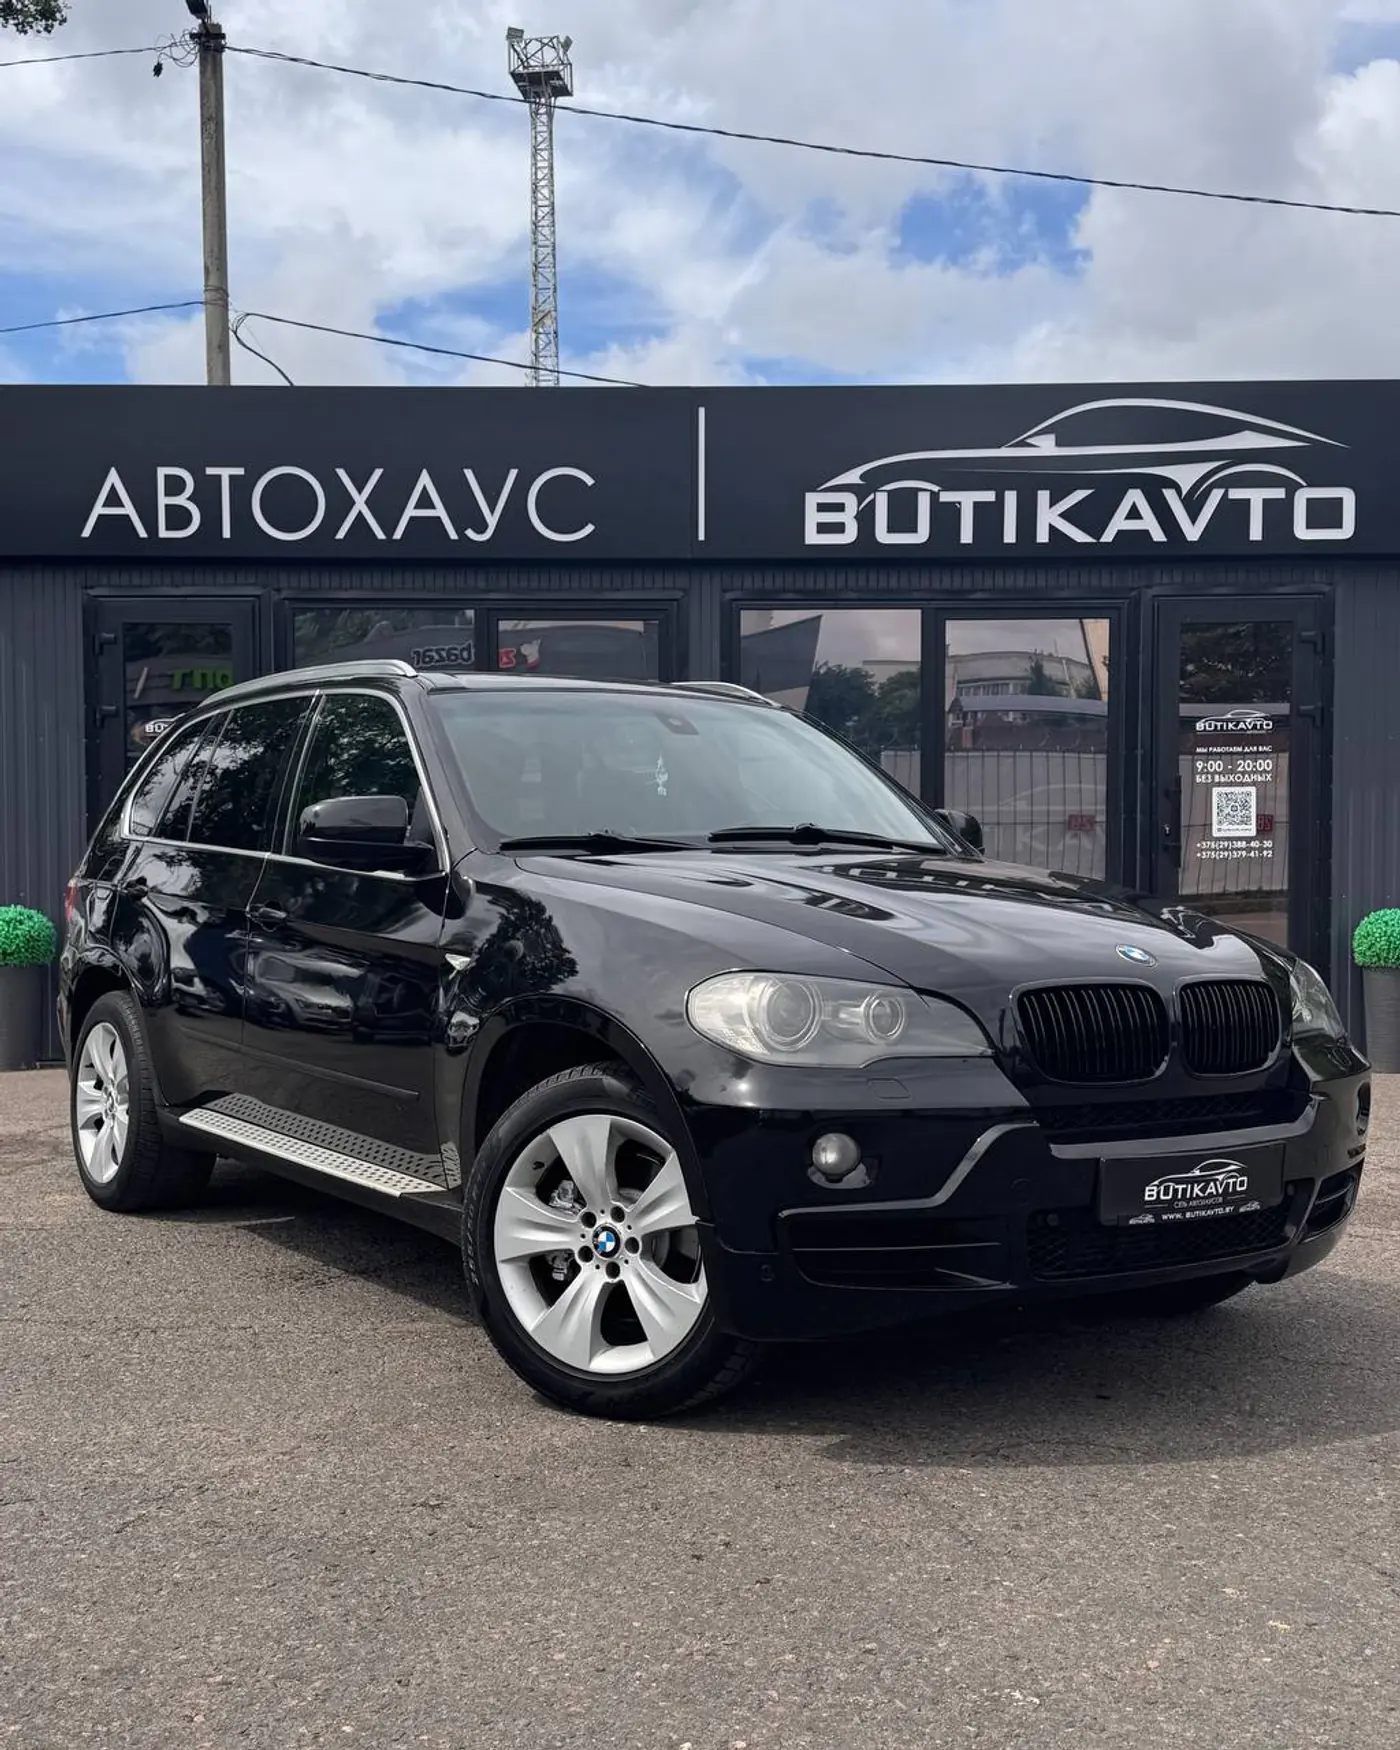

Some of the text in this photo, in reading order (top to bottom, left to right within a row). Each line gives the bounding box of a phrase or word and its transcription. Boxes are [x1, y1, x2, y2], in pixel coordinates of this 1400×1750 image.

[80, 465, 597, 543] АВТОХАУС
[804, 485, 1356, 546] BUTIKAVTO
[1196, 720, 1273, 731] BUTIKAVTO
[1196, 760, 1224, 772] 9:00
[1236, 759, 1273, 771] 20:00
[1196, 773, 1272, 783] БЕЗ ВЫХОДНЫХ
[1144, 1176, 1248, 1202] BUTIKAVTO
